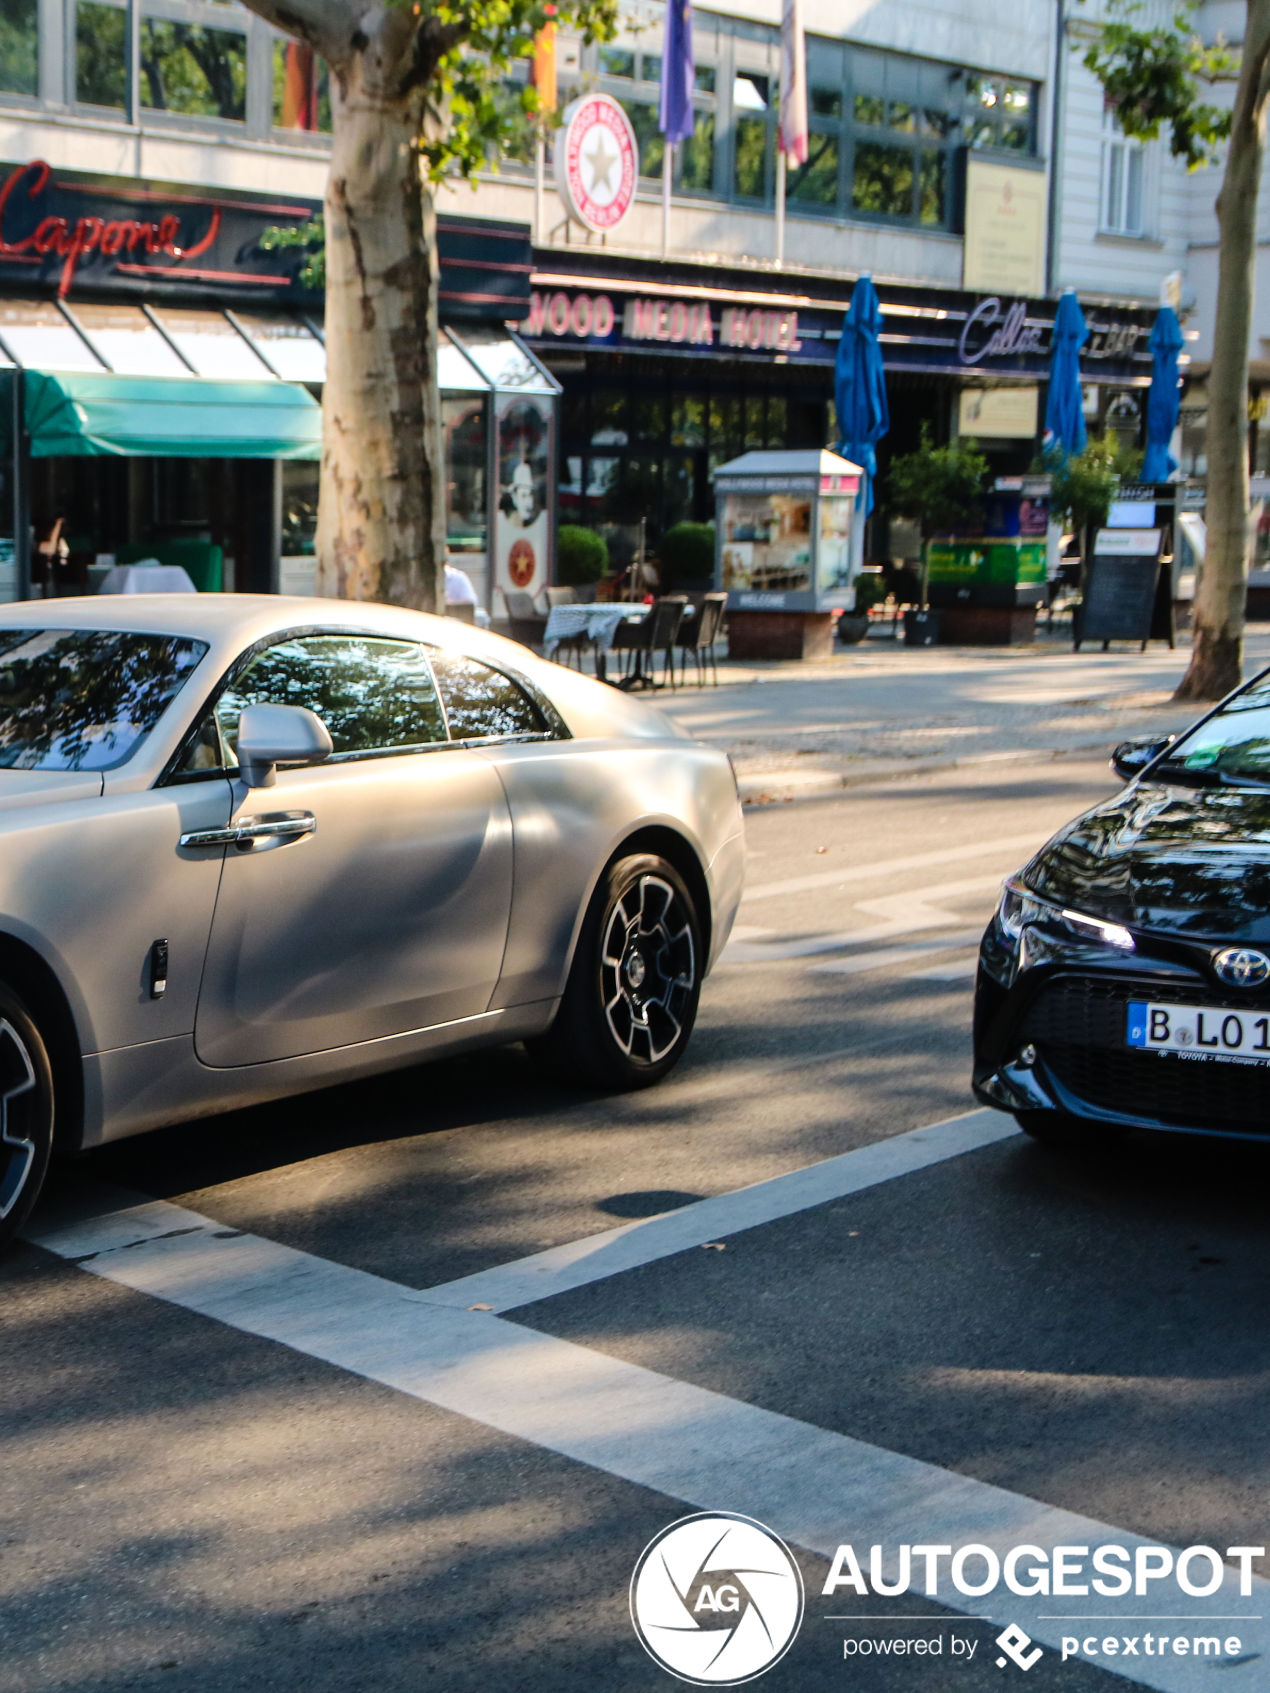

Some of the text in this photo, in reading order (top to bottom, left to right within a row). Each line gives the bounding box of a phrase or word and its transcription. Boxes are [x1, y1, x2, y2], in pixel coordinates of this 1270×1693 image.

[623, 298, 713, 346] MEDIA
[720, 307, 802, 352] HOTEL
[740, 594, 785, 607] WELCOME
[1150, 1009, 1170, 1042] B
[1178, 1051, 1208, 1062] TOYOTA
[1215, 1054, 1232, 1063] Motor
[1232, 1055, 1259, 1066] Company
